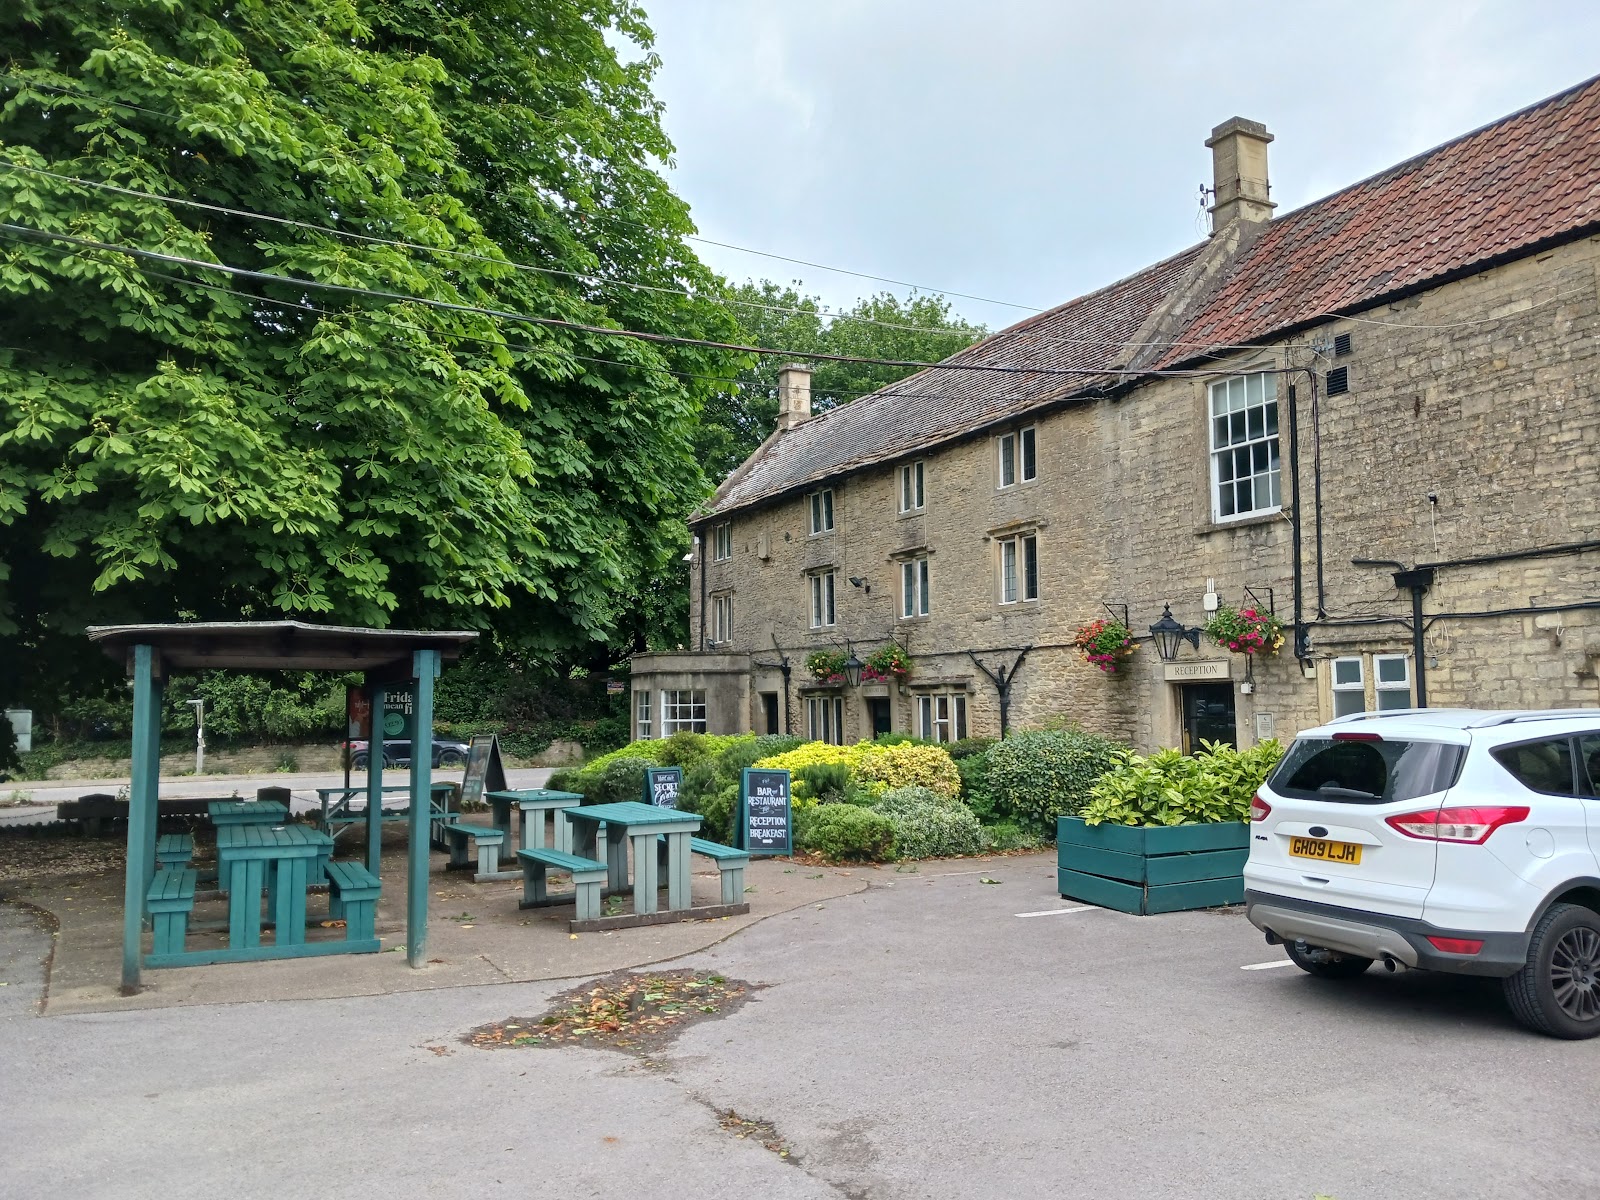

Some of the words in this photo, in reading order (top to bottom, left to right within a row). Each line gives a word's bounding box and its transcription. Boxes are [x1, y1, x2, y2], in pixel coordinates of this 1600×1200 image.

[1174, 664, 1217, 675] RECEPTION
[384, 691, 413, 702] Frida
[405, 702, 413, 714] fi
[654, 783, 678, 791] SECRET
[757, 786, 773, 796] BAR
[748, 796, 787, 806] RESTAURANT
[750, 816, 786, 827] RECEPTION
[750, 828, 786, 839] BREAKFAST
[1293, 838, 1326, 857] GH09
[1327, 842, 1356, 861] LJH
